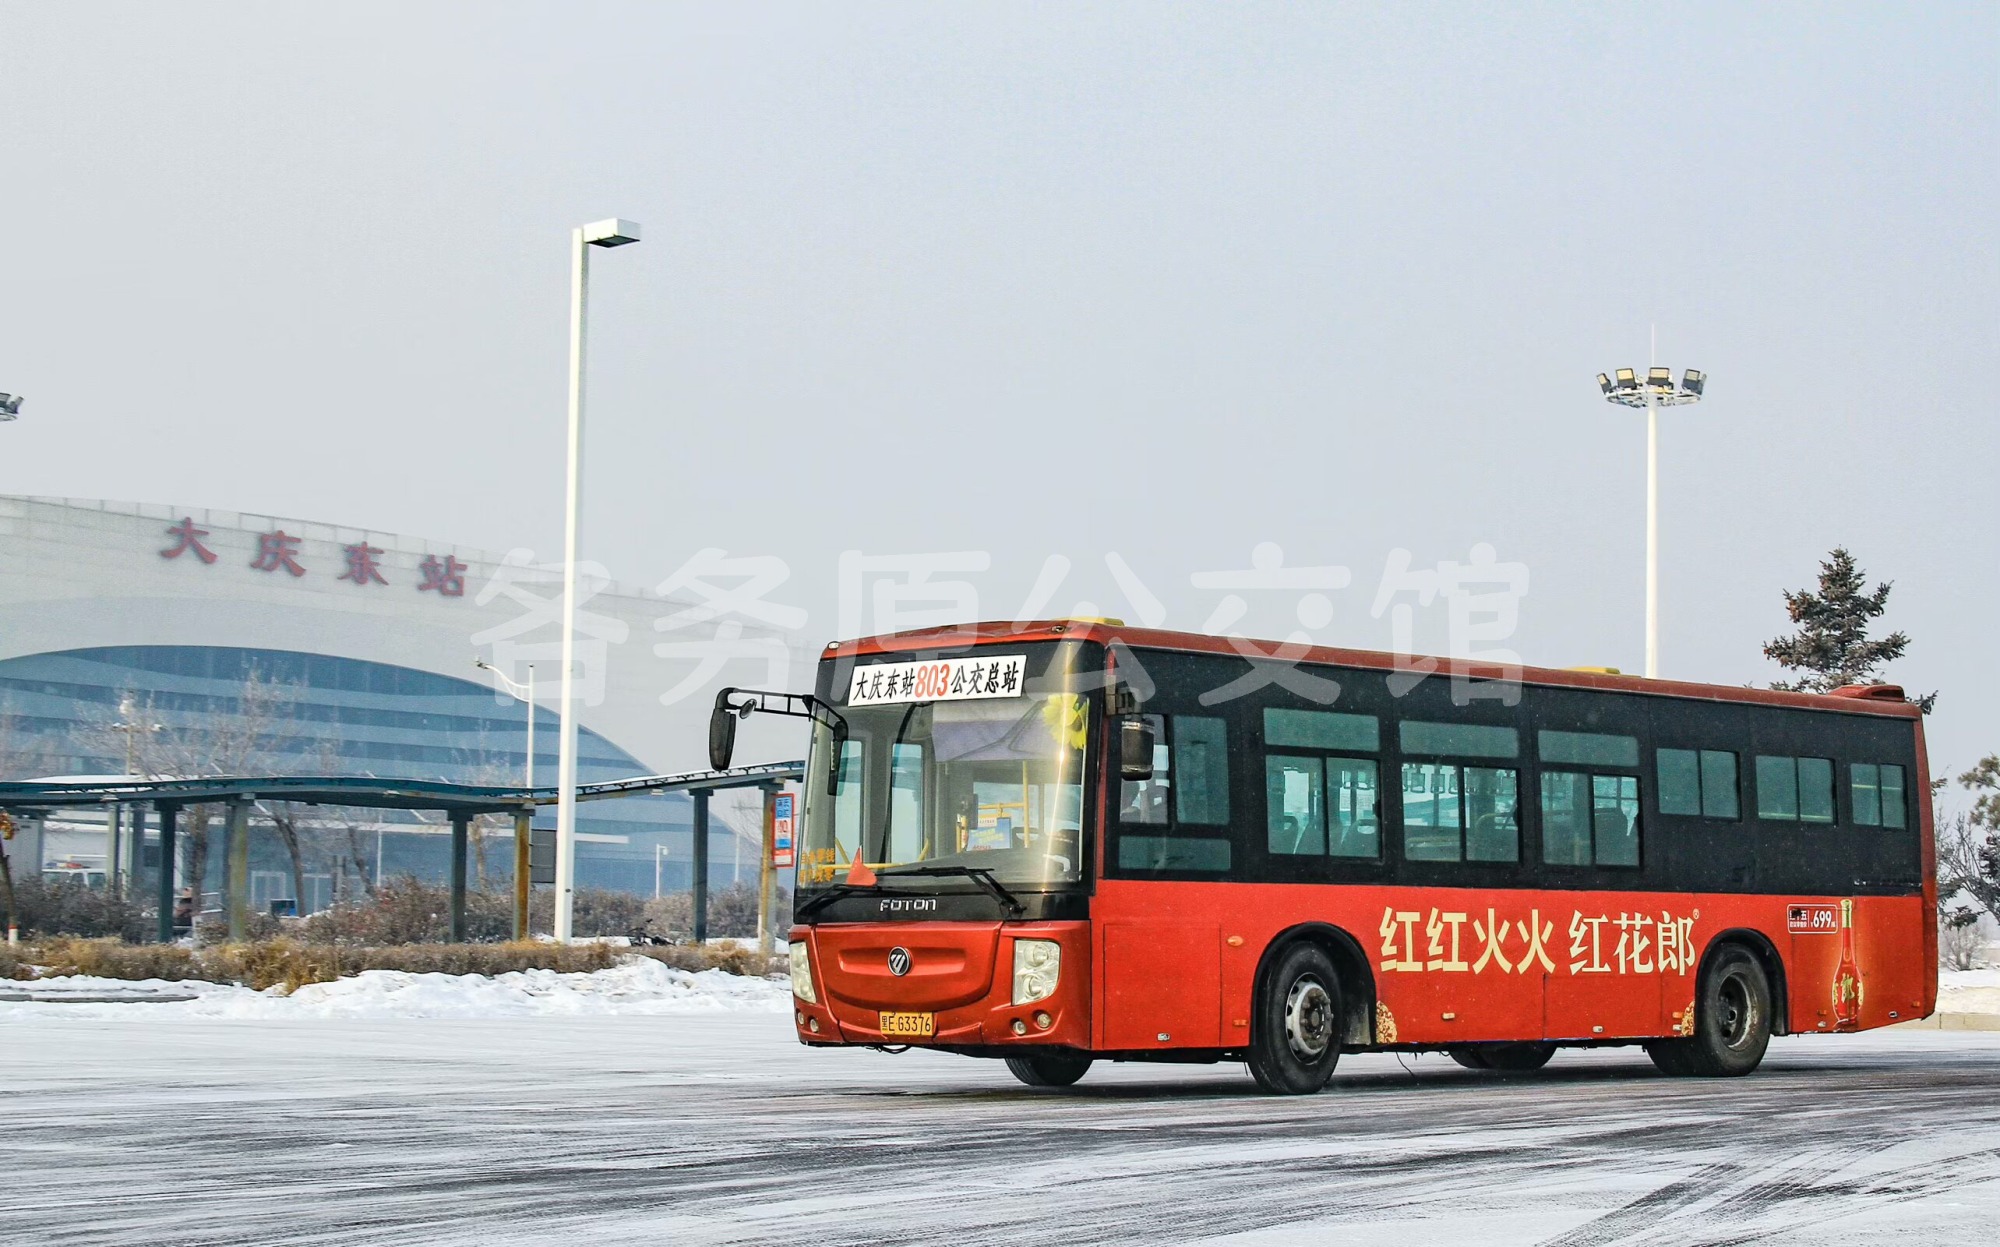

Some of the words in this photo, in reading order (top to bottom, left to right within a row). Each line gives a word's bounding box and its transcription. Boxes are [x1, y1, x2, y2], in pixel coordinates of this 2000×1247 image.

[160, 517, 468, 597] 大庆东站
[853, 661, 1019, 701] 大庆东站803公交总站
[880, 899, 936, 911] FOTON
[1379, 906, 1556, 975] 红红火火
[1568, 909, 1695, 976] 红花郎
